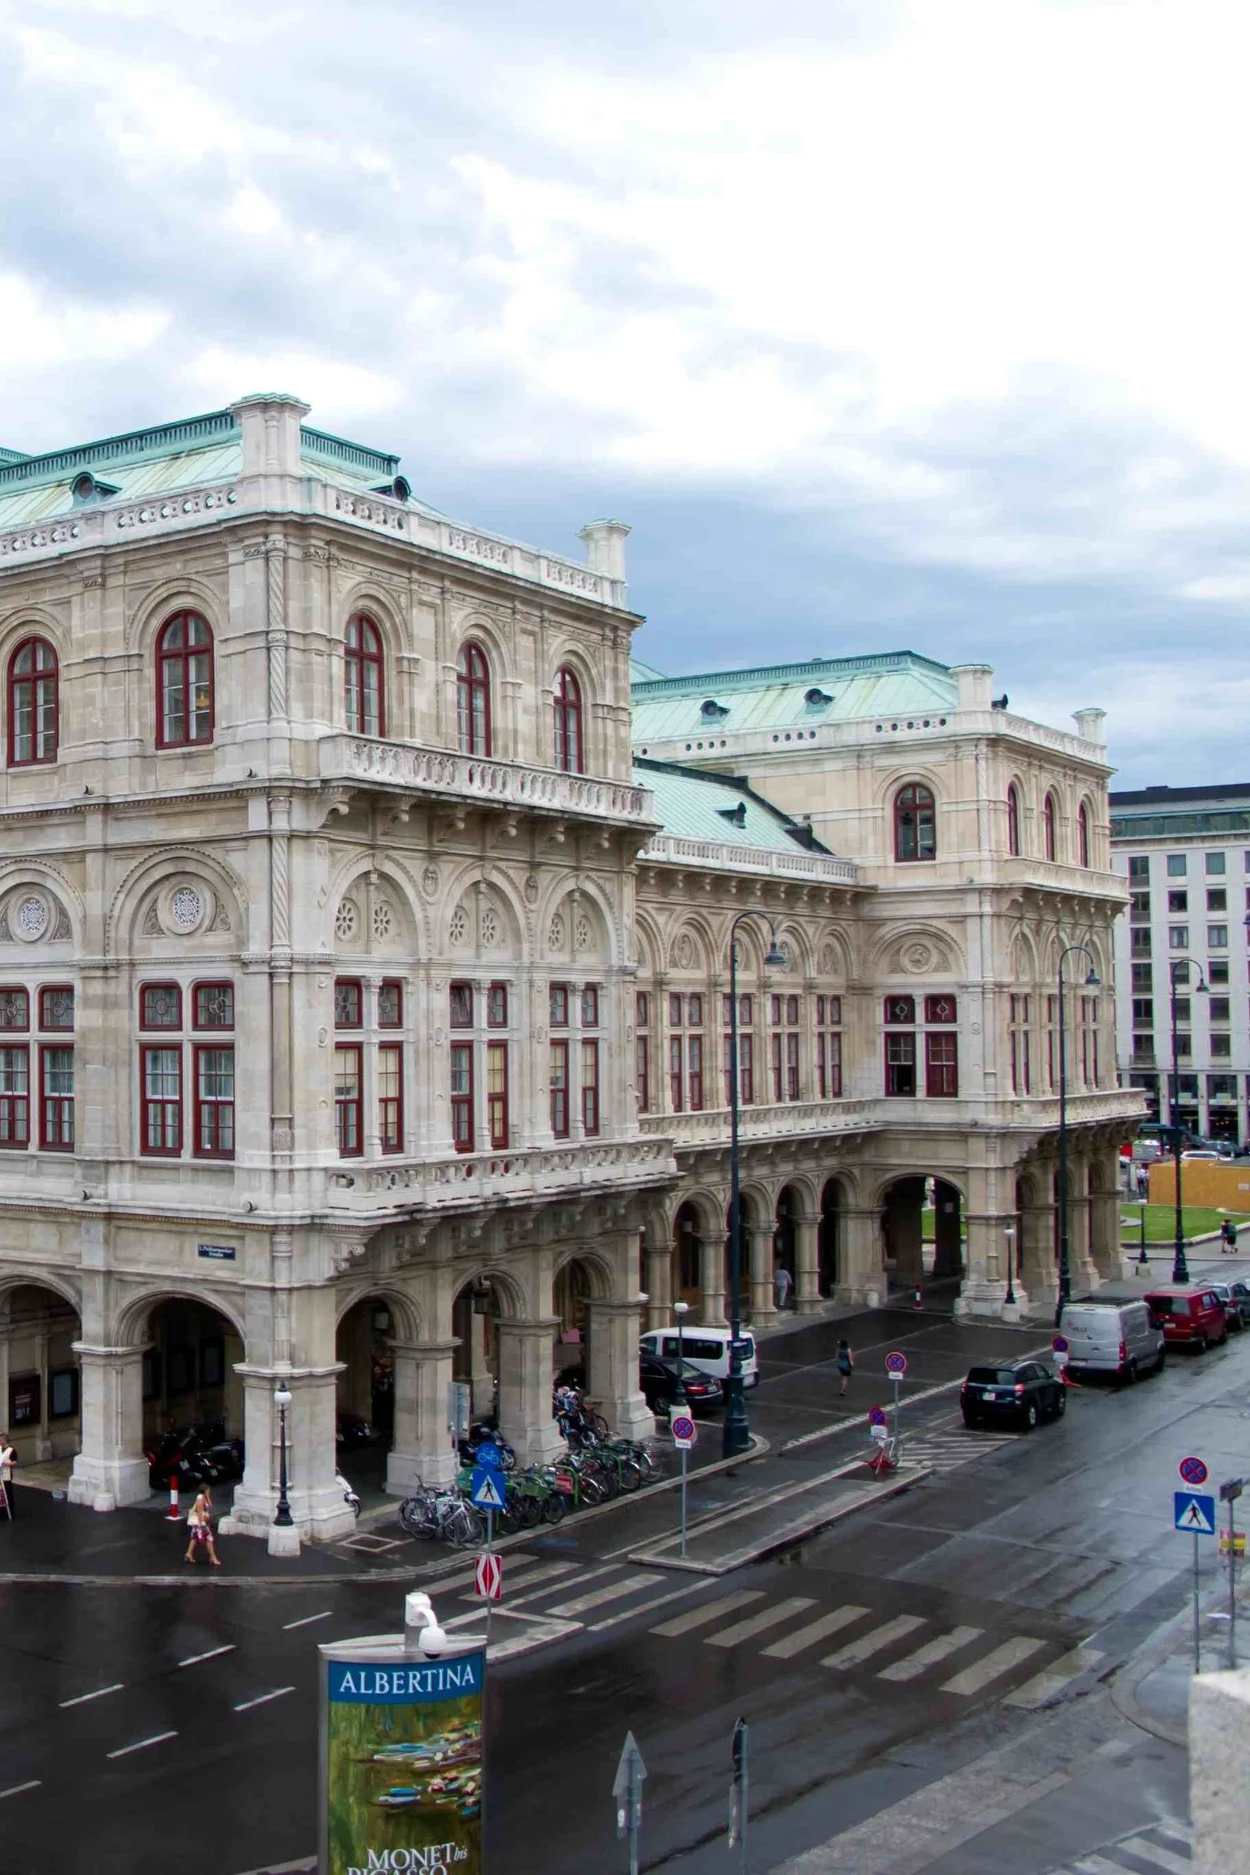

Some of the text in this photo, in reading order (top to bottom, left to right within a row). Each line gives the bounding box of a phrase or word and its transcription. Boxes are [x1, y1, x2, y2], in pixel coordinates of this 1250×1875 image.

[340, 1664, 475, 1694] ALBERTINA
[367, 1842, 468, 1869] MONET bis
